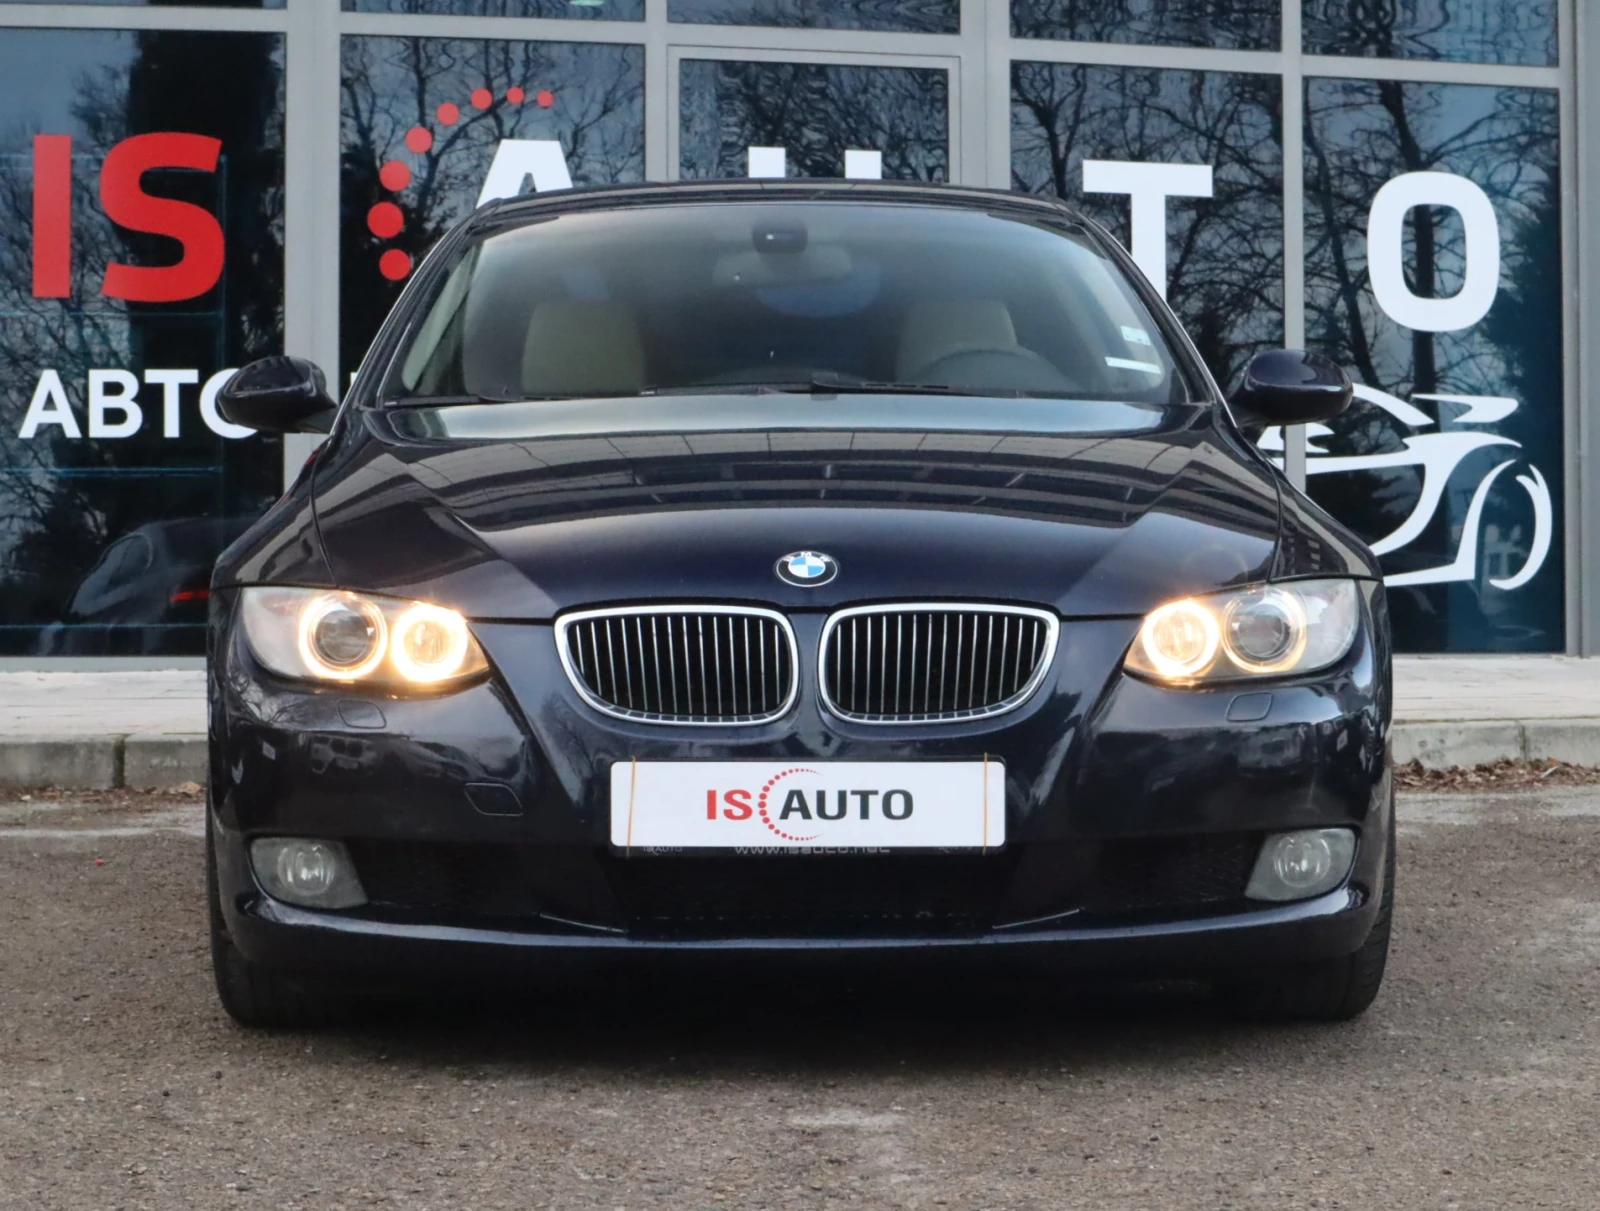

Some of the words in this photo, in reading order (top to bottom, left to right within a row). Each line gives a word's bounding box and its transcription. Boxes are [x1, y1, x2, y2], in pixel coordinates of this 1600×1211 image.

[33, 132, 225, 302] IS
[472, 140, 1499, 331] TO
[707, 789, 753, 820] IS
[779, 790, 914, 820] AUTO
